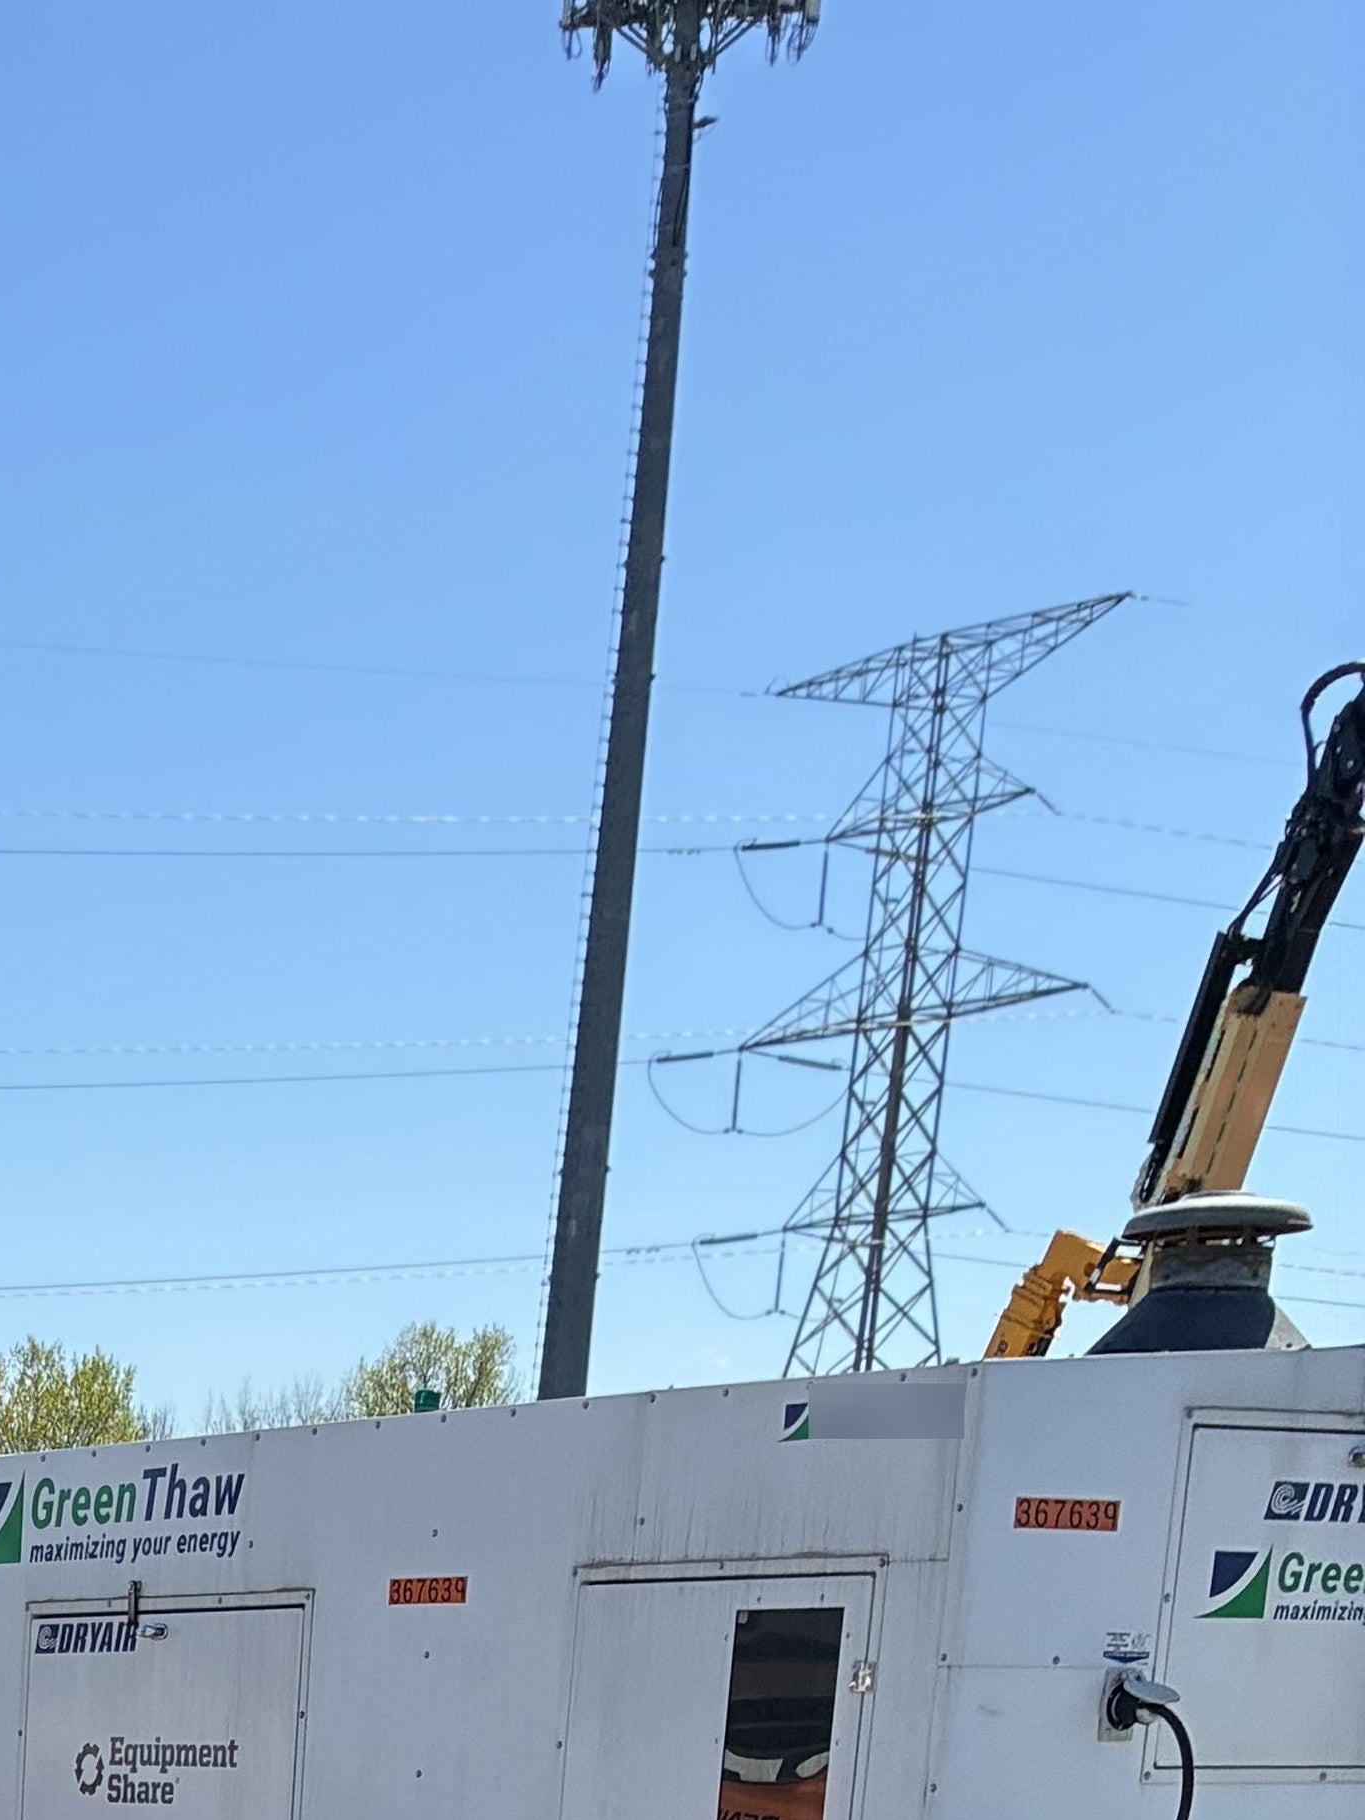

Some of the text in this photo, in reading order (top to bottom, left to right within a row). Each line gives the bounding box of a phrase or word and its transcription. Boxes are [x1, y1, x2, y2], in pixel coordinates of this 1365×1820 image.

[1017, 1498, 1117, 1529] 367639
[29, 1530, 241, 1564] maximizing your energy
[390, 1578, 464, 1603] 367639
[1273, 1599, 1365, 1625] maximizin
[57, 1622, 139, 1654] DRYAIR
[108, 1736, 239, 1774] Equipment
[107, 1773, 175, 1804] Share
